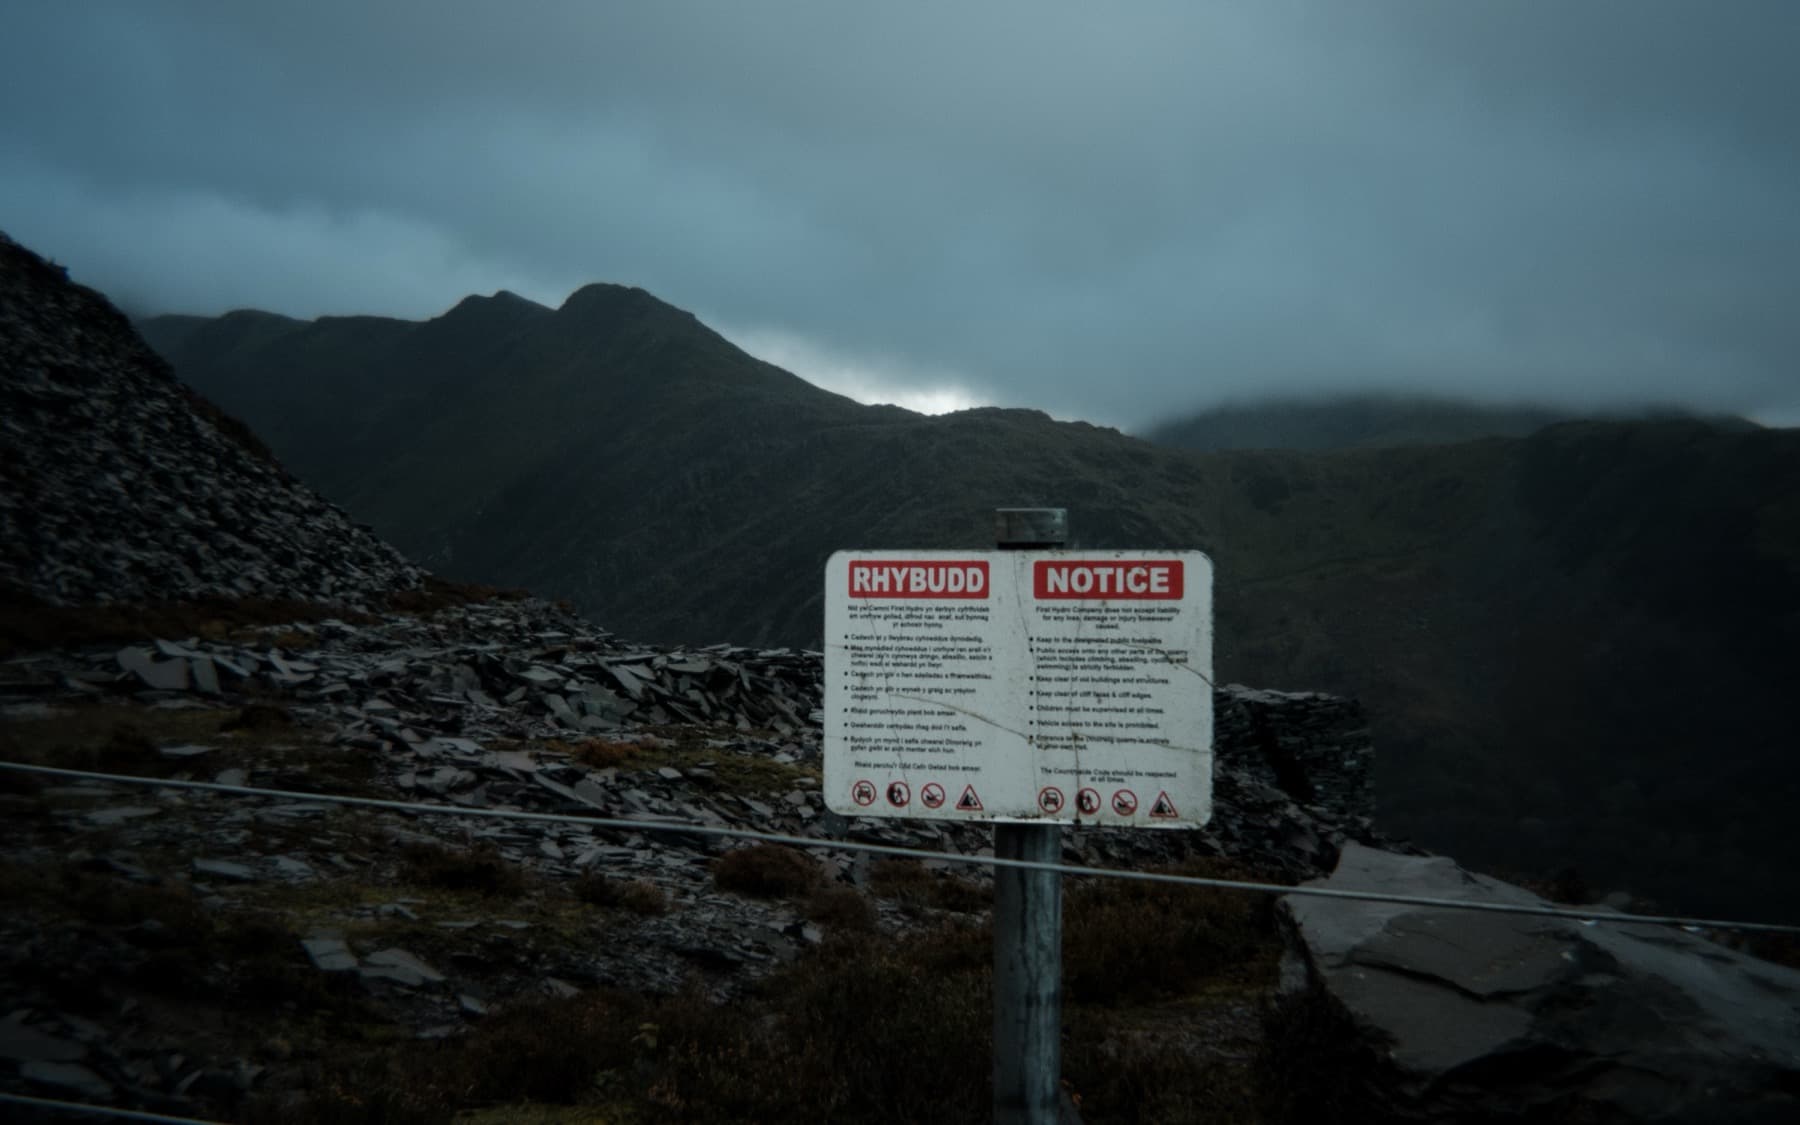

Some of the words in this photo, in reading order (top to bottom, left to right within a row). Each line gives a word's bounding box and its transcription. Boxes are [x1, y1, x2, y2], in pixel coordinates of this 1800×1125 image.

[854, 567, 984, 593] RHYBUDD
[1047, 566, 1170, 593] NOTICE
[1145, 770, 1176, 778] respected
